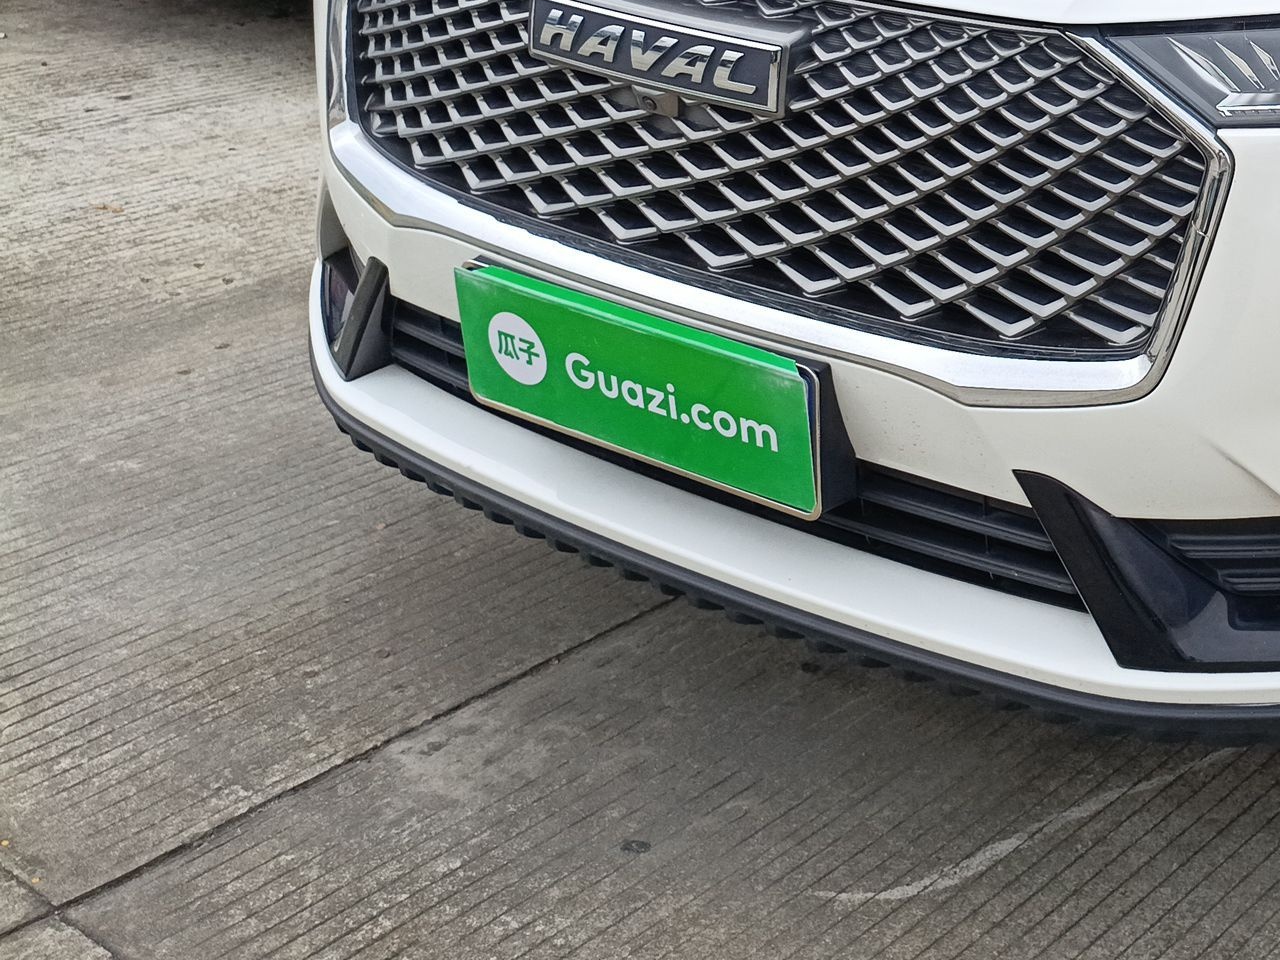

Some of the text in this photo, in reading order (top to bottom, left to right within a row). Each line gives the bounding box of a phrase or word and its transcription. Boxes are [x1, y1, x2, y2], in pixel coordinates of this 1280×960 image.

[539, 8, 757, 95] HAVAL
[497, 330, 540, 366] 瓜子
[564, 352, 780, 453] Guazi.com
